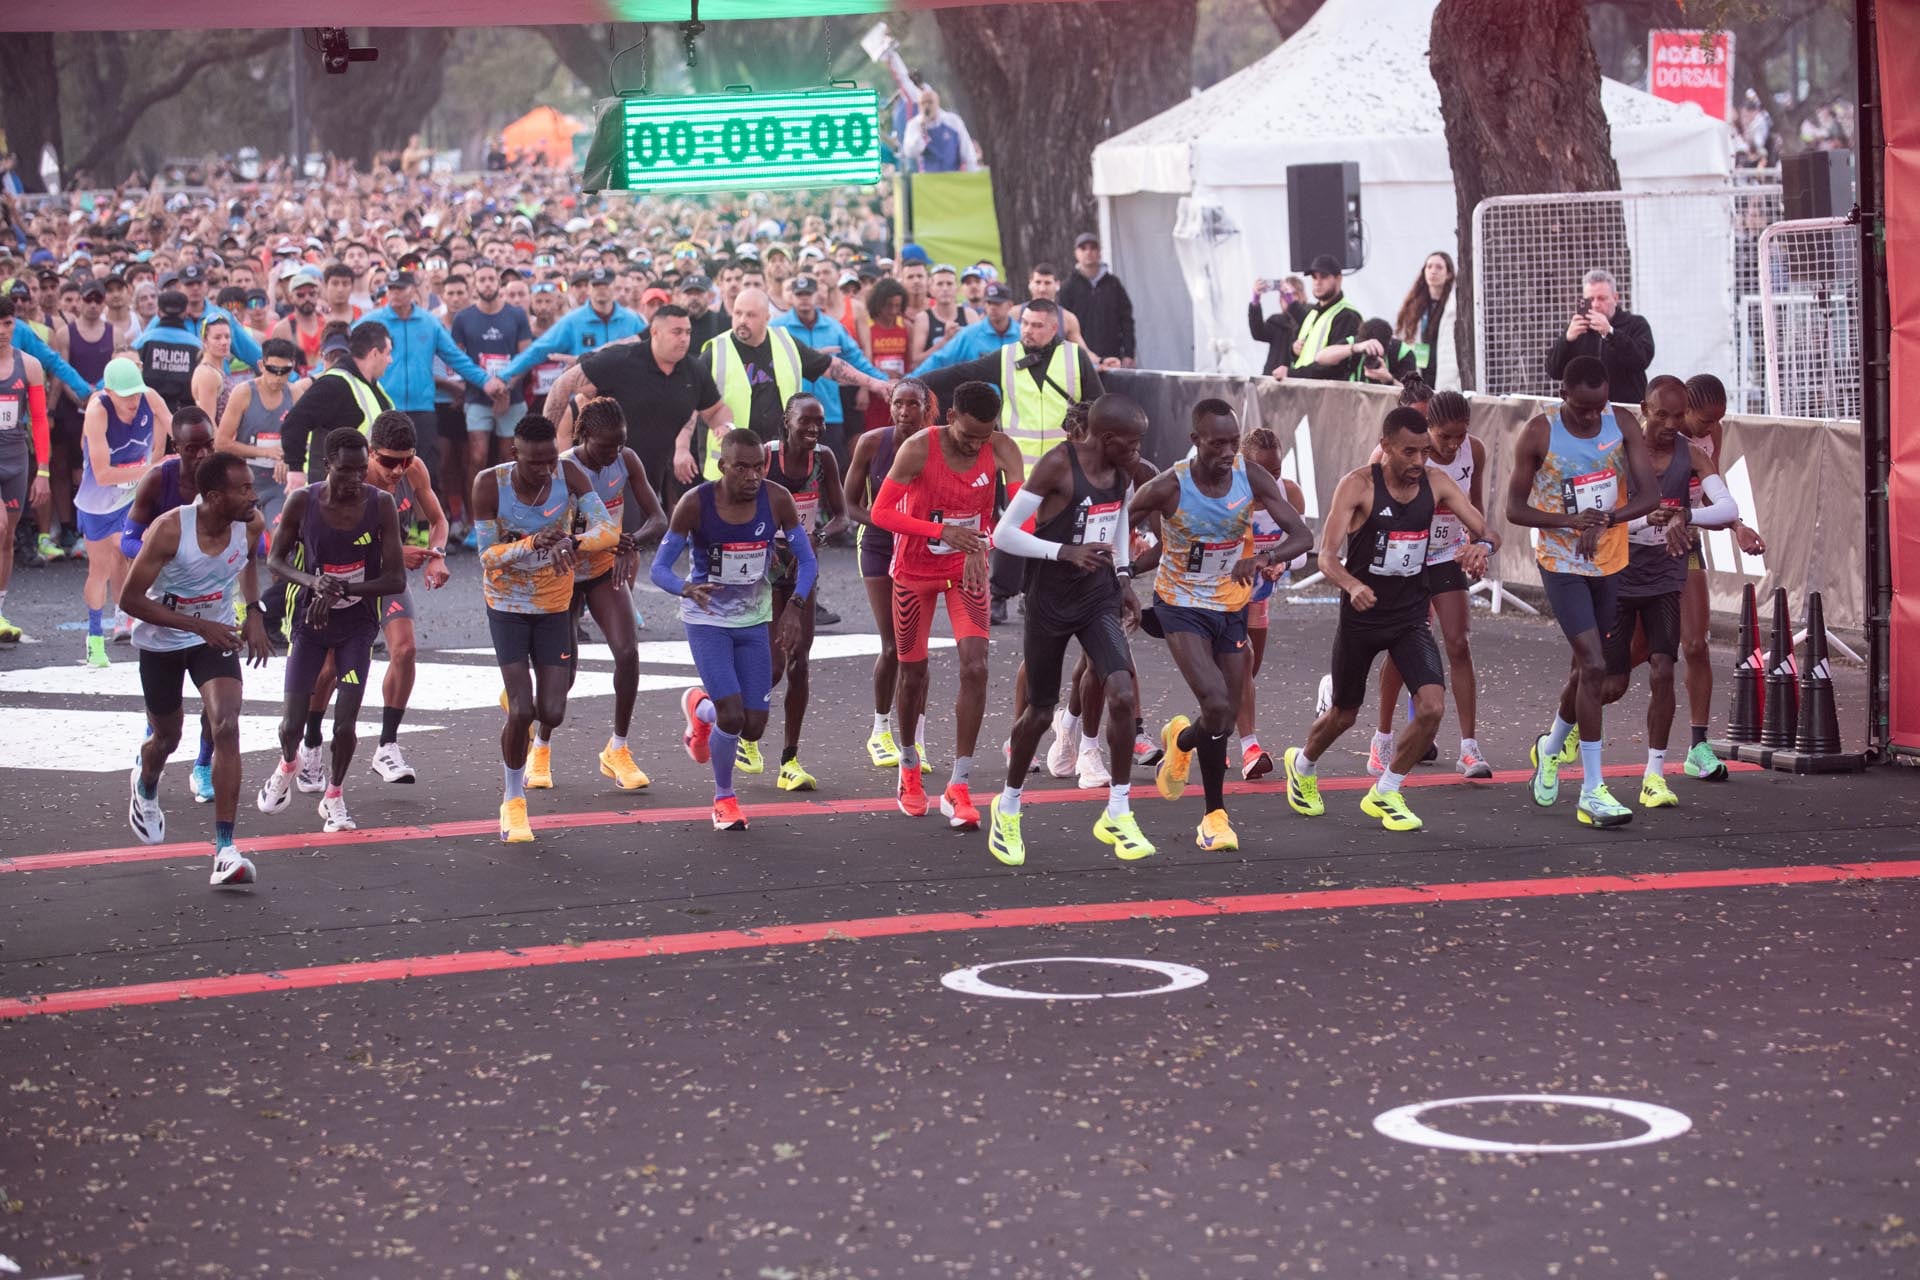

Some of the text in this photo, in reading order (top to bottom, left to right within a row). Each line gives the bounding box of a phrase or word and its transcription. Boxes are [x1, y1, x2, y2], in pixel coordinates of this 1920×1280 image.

[1656, 67, 1723, 87] DORSAL
[633, 113, 871, 167] 00:00:00
[152, 348, 190, 363] POLICIA
[1595, 495, 1603, 509] 5
[1100, 526, 1106, 541] 6
[1434, 526, 1449, 538] 55
[536, 549, 549, 561] 12
[1402, 554, 1411, 567] 3
[739, 562, 748, 575] 4
[1219, 559, 1228, 570] 7
